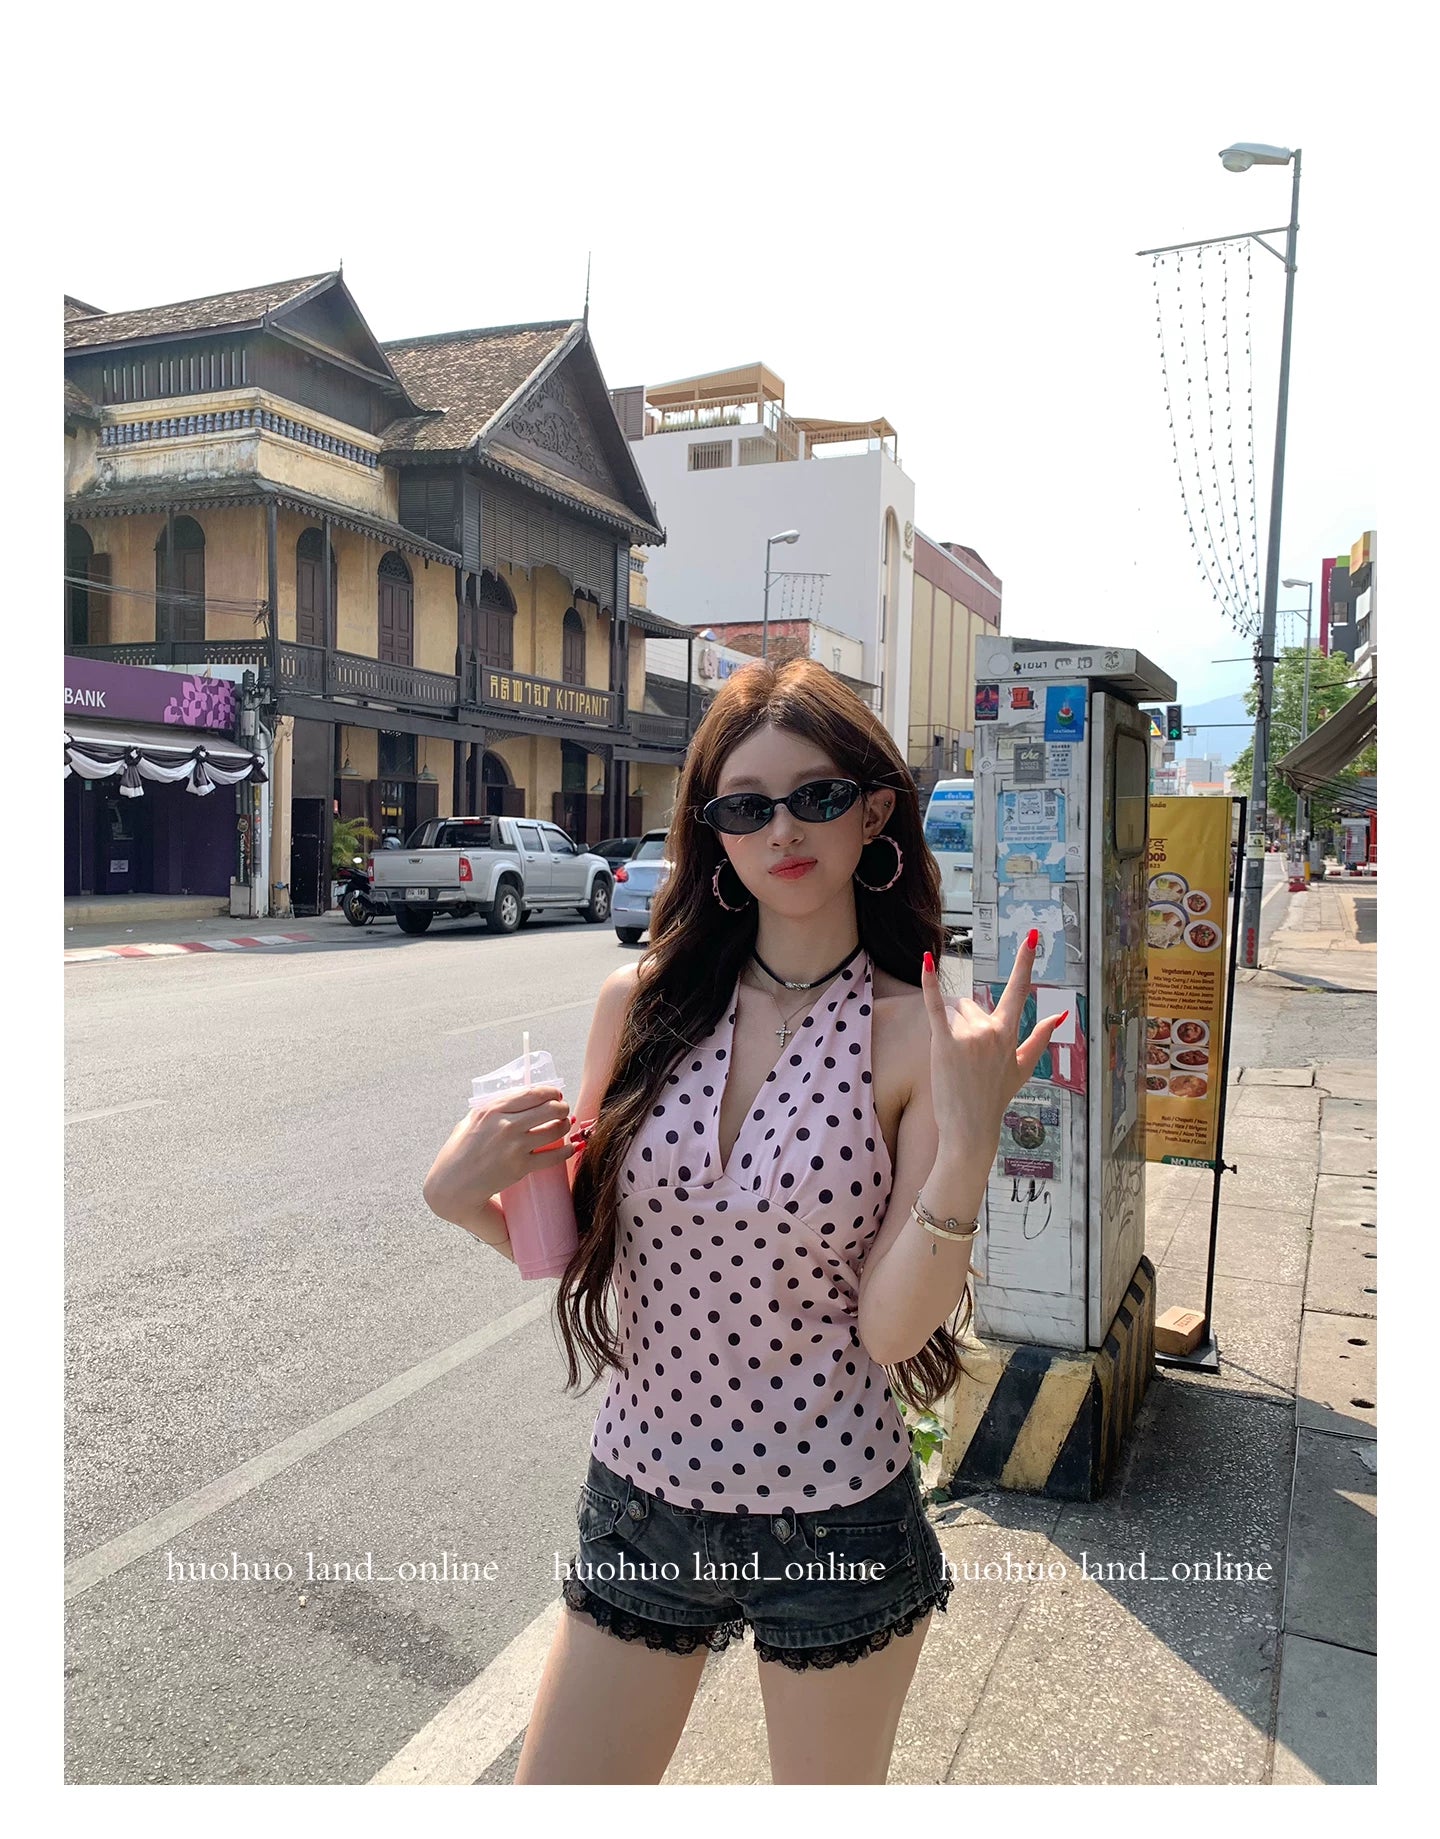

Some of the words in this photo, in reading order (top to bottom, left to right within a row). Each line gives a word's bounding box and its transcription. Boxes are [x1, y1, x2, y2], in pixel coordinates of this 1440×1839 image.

[64, 687, 106, 708] BANK
[556, 688, 609, 717] KITIPANIT
[1147, 852, 1167, 861] OOD
[1170, 1157, 1186, 1167] NO
[1187, 1159, 1210, 1168] MSG
